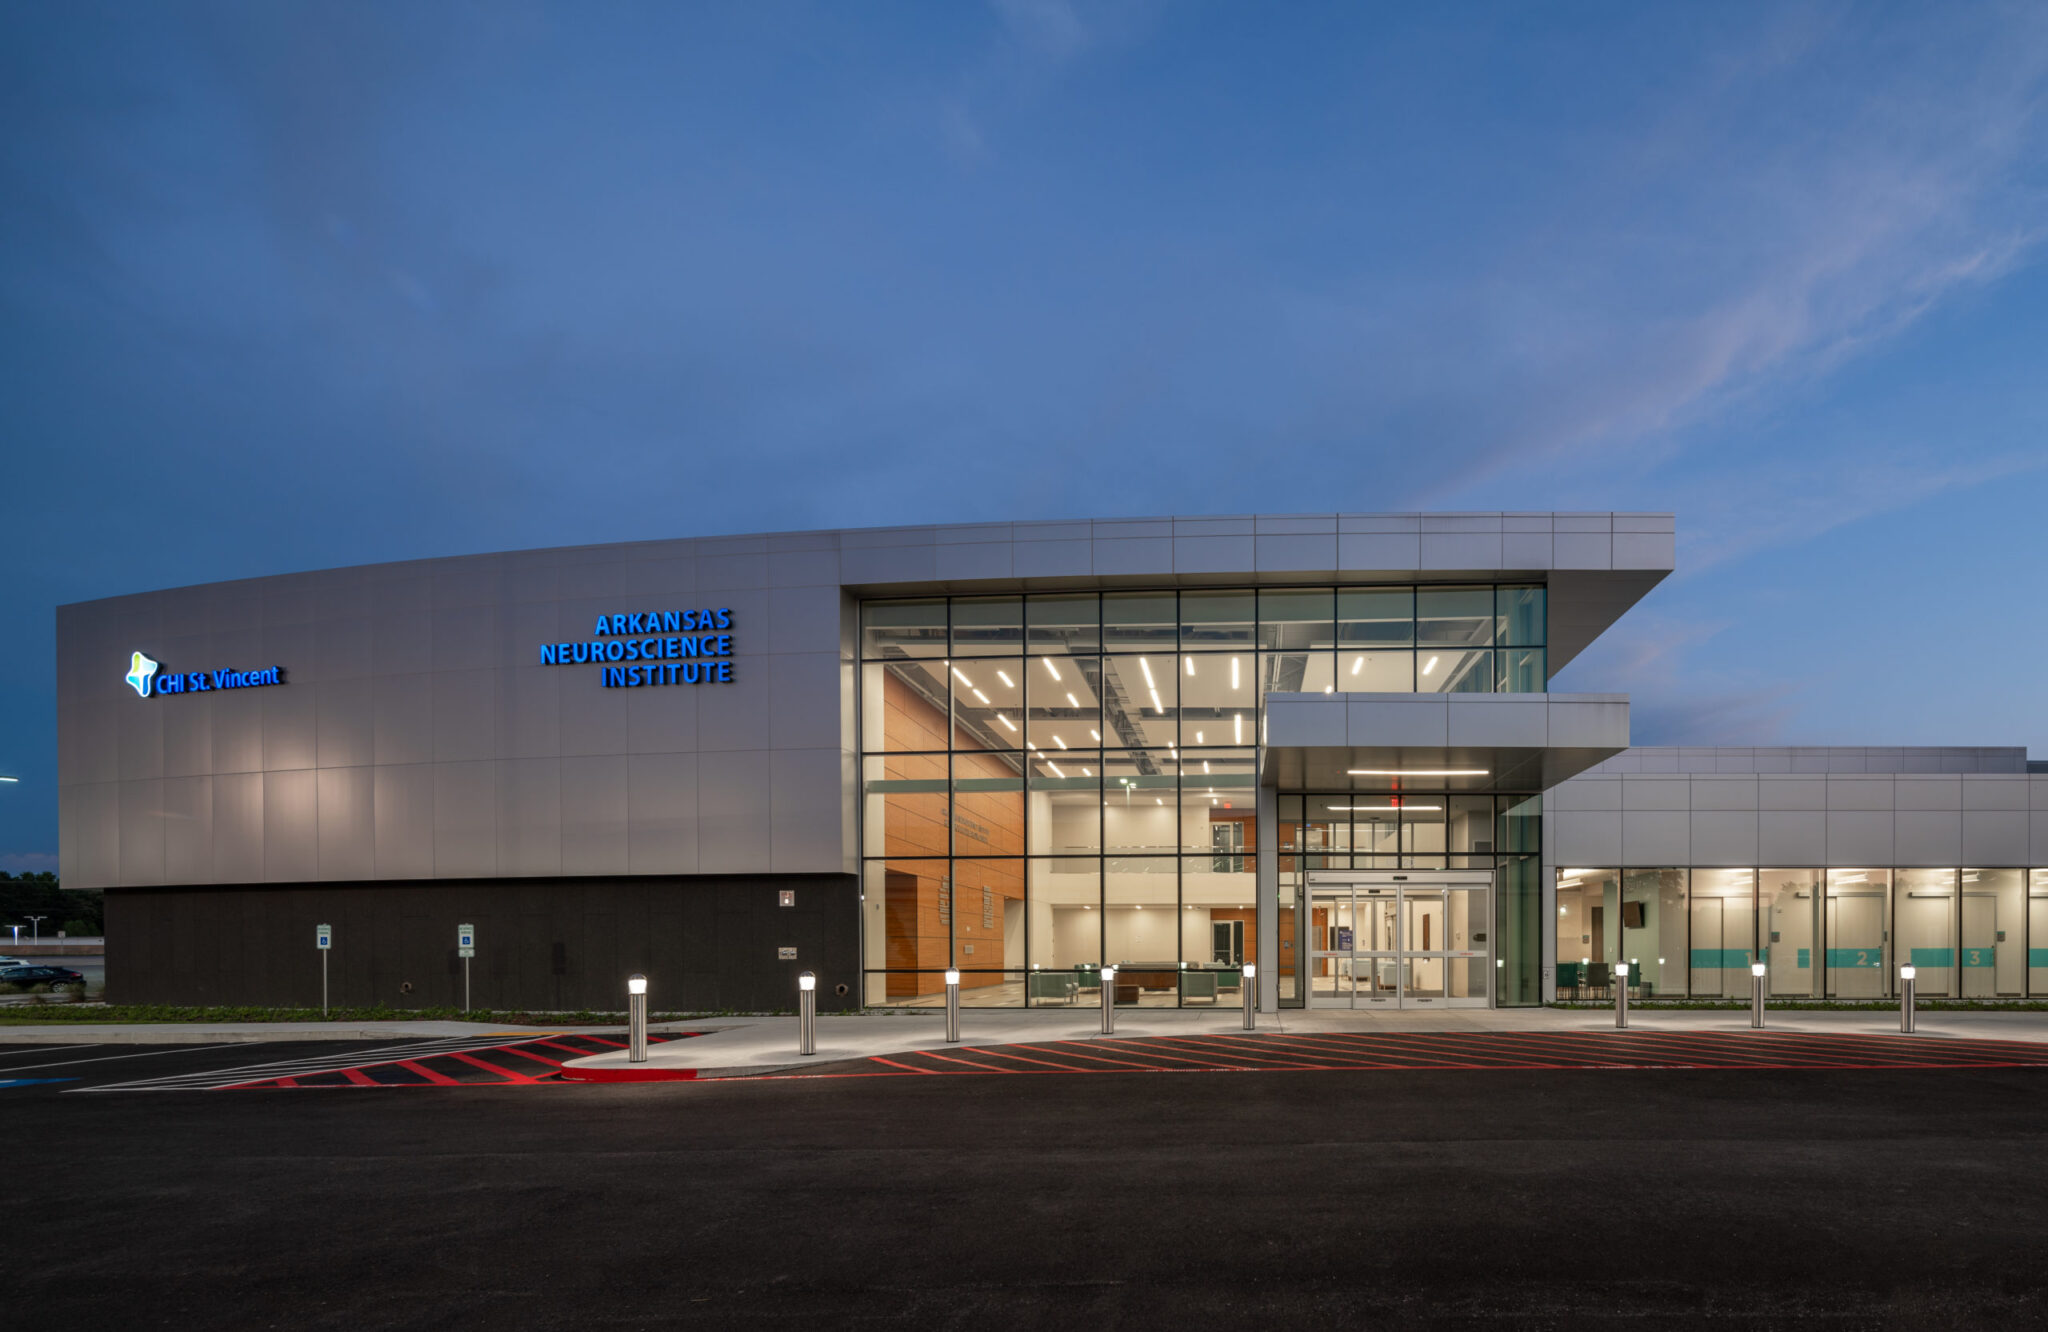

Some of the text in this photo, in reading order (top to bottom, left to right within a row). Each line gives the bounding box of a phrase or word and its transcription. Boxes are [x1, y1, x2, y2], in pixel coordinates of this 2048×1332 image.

[594, 608, 731, 636] ARKANSAS
[540, 634, 731, 665] NEUROSCIENCE
[155, 665, 280, 695] CHI St. Vincent
[601, 661, 731, 688] INSTITUTE
[1856, 951, 1868, 965] 2
[1969, 951, 1980, 965] 3
